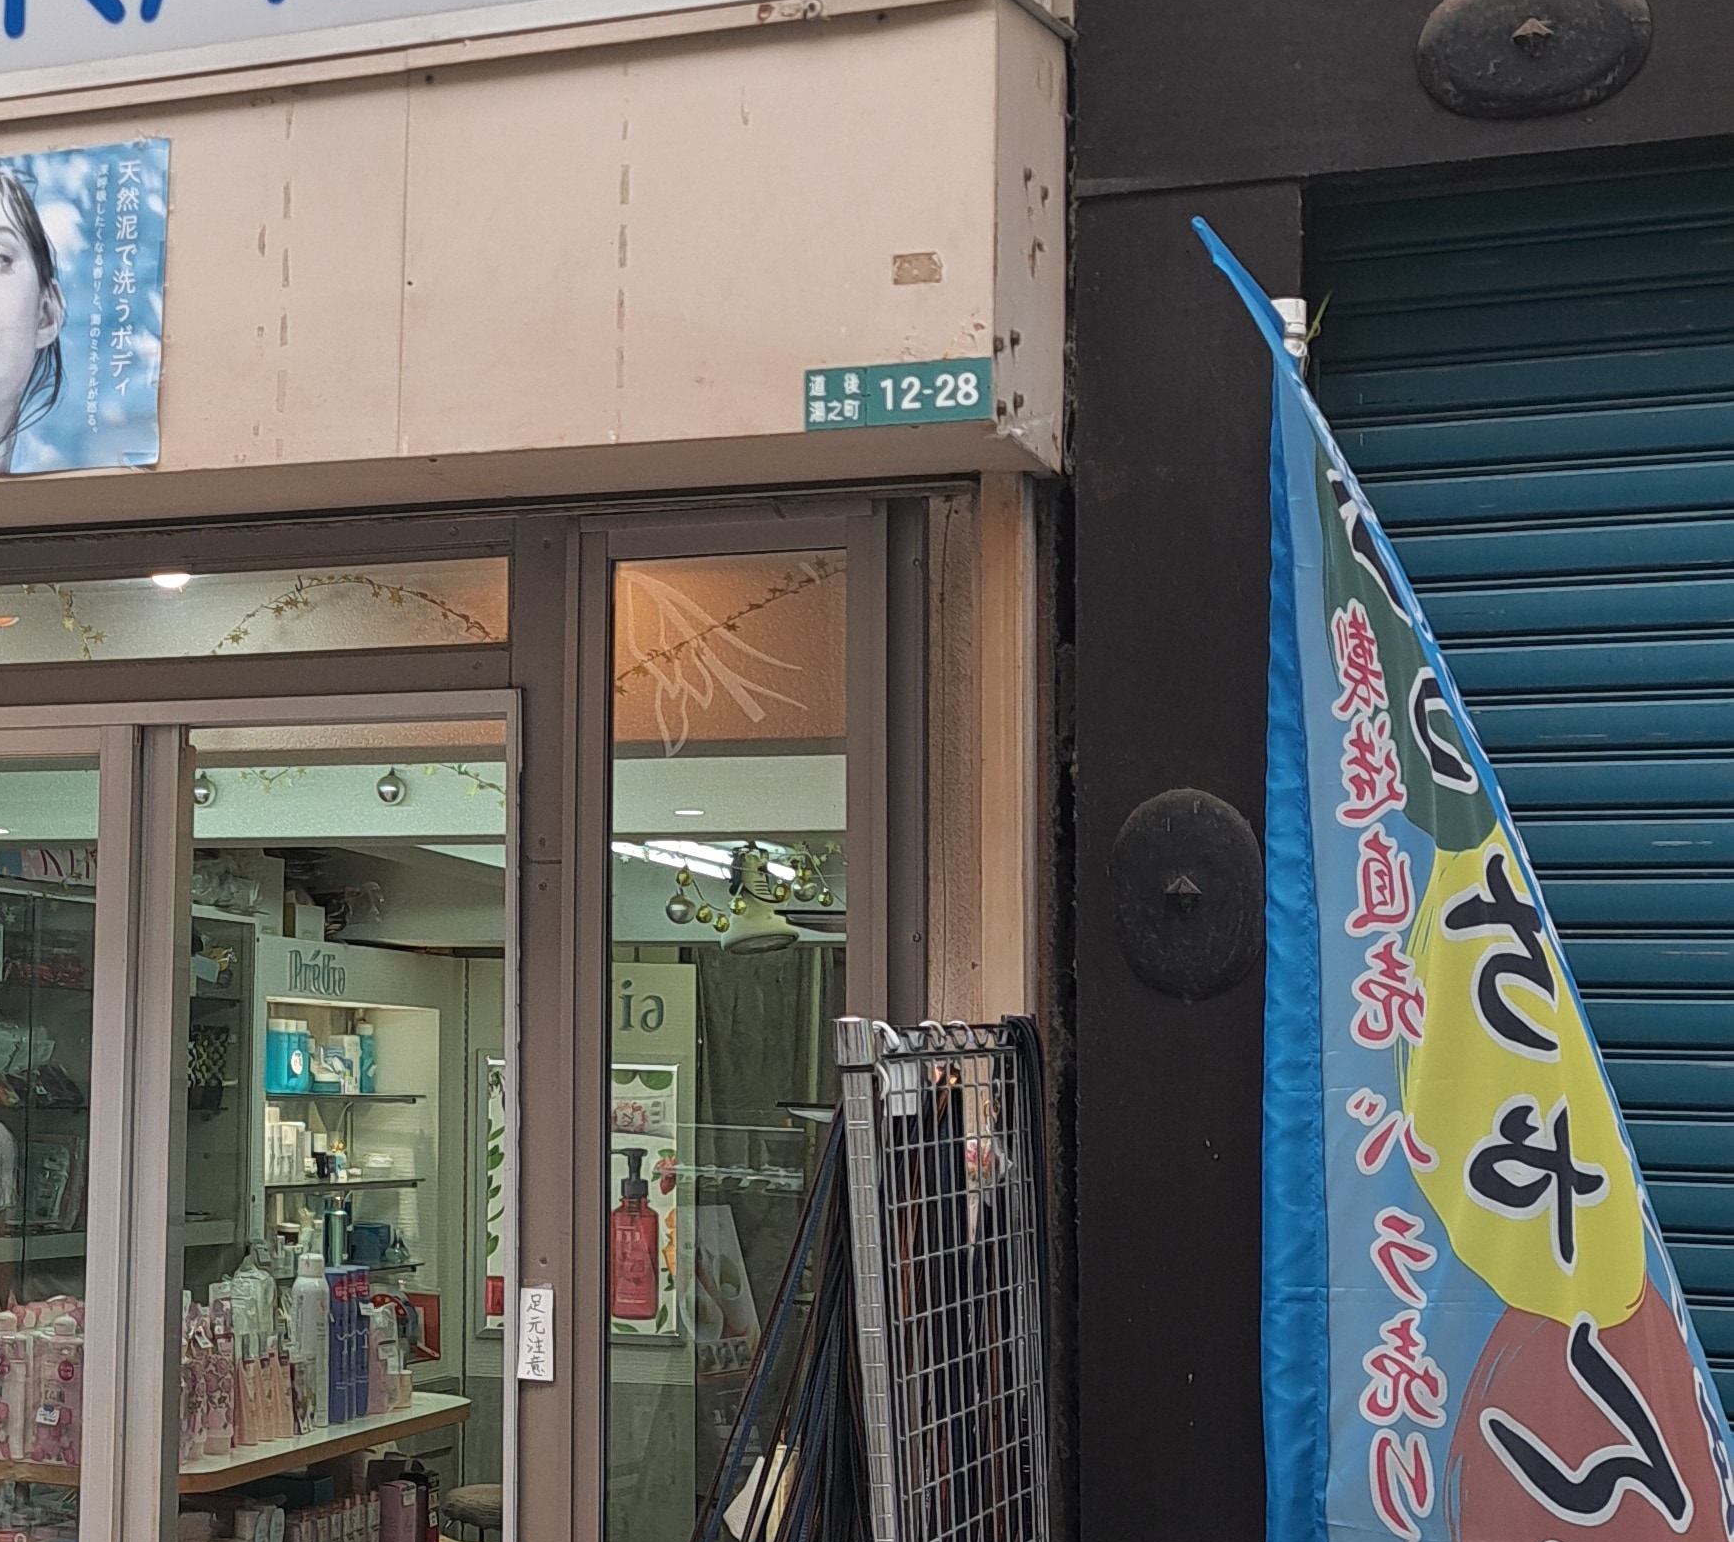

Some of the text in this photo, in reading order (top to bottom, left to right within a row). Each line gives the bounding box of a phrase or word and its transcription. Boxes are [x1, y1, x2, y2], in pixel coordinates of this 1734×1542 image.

[109, 160, 142, 396] 天然泥で洗うボディ
[809, 373, 861, 397] 道後
[880, 372, 979, 411] 12-28
[809, 400, 861, 423] 湯之町
[525, 1293, 546, 1377] 足元注意
